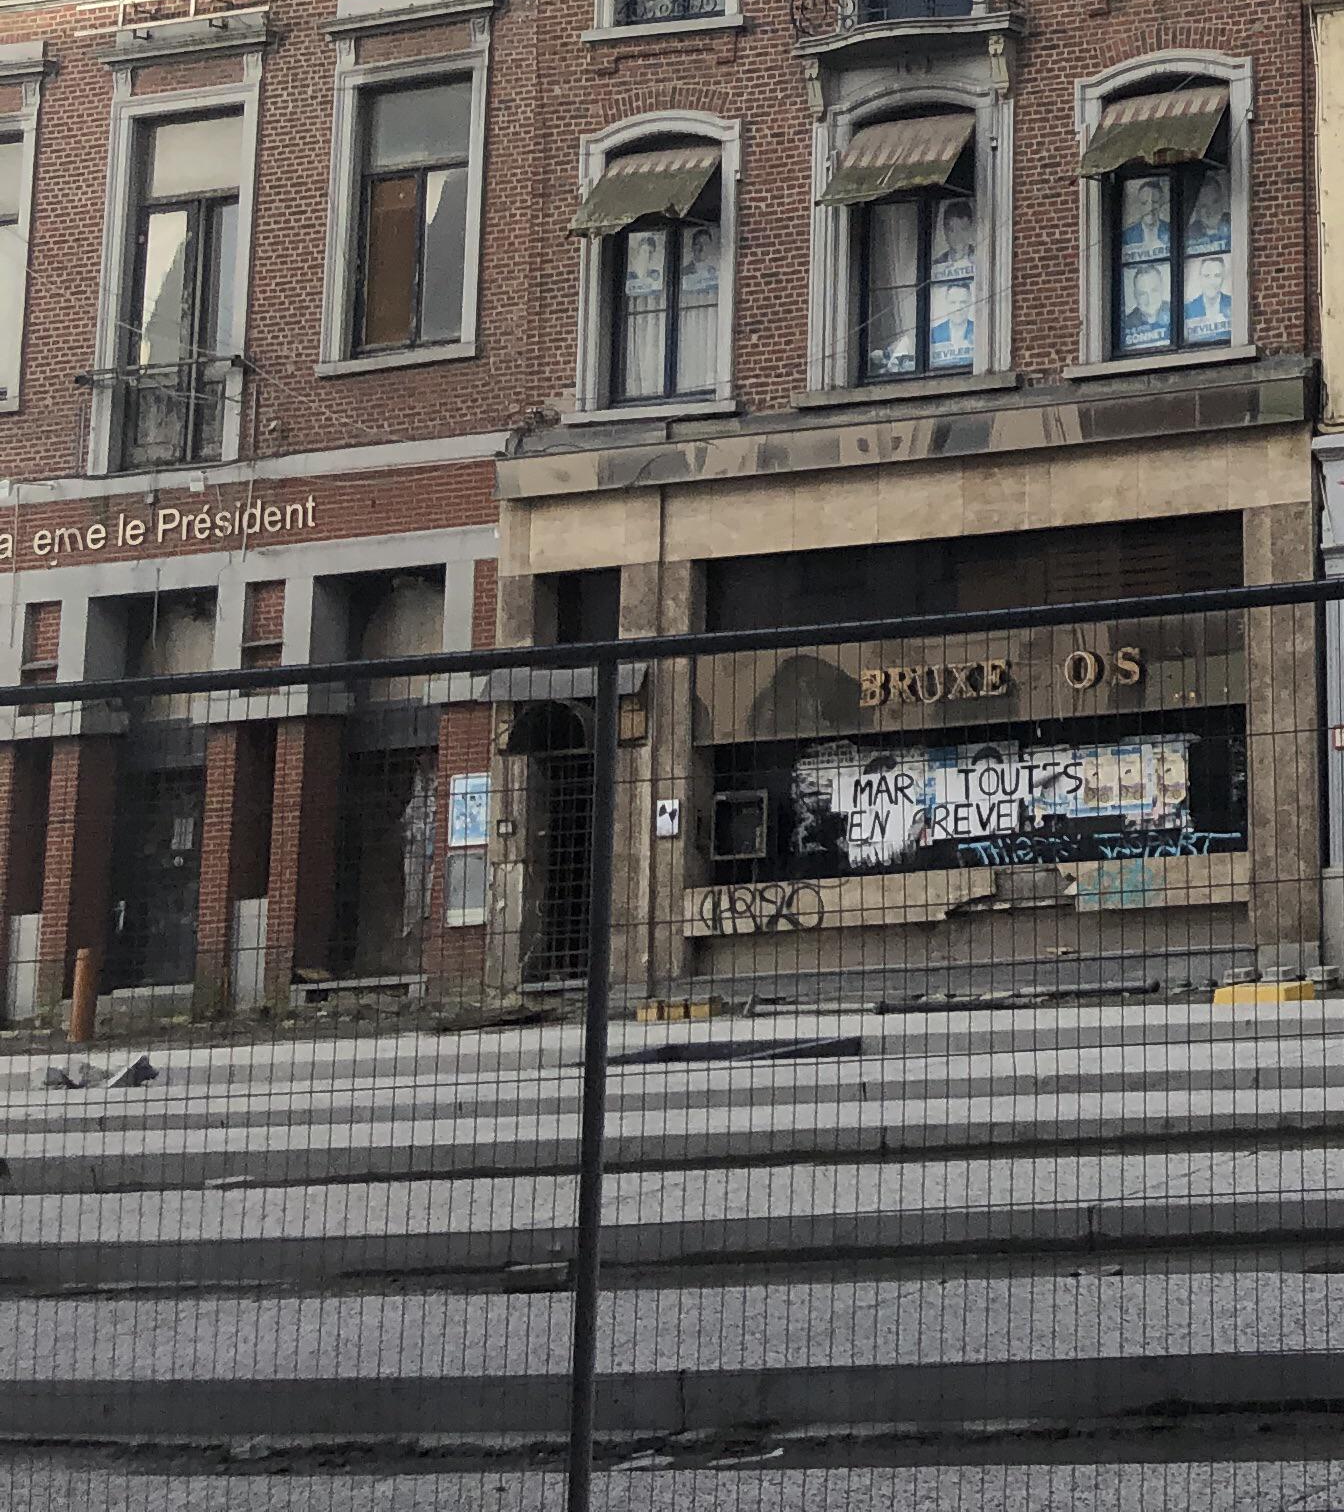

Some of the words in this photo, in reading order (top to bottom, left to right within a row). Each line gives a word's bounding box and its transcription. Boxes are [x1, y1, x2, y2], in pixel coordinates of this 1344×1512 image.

[33, 521, 107, 556] eme
[117, 512, 146, 547] le
[157, 493, 316, 543] Président
[859, 658, 1008, 707] BRUXE
[852, 772, 915, 808] MAR
[848, 808, 891, 843] EN
